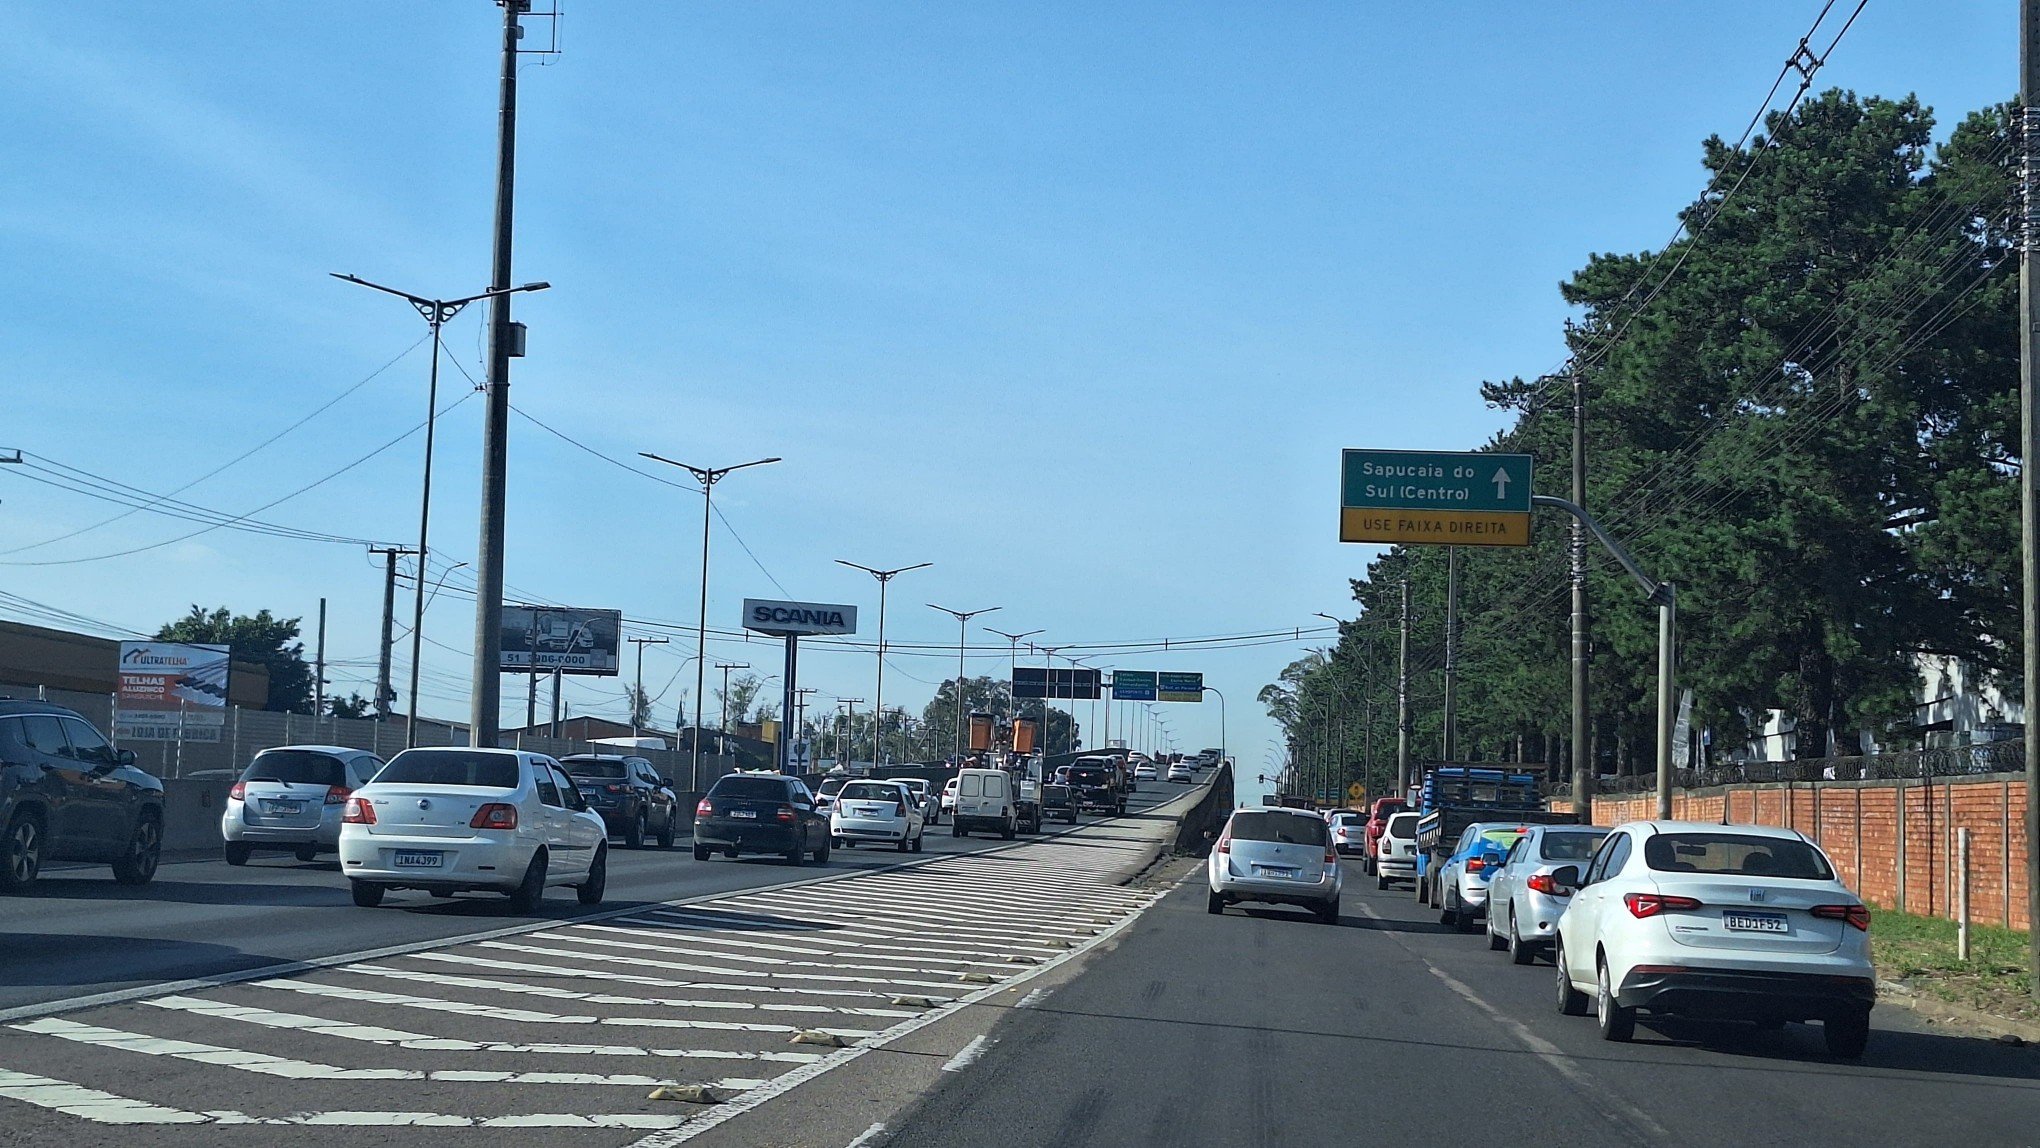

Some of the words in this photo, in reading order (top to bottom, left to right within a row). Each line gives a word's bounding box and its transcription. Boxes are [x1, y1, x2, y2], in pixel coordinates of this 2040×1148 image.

[1363, 462, 1443, 478] Sapucaia
[1454, 465, 1475, 478] do
[1366, 485, 1393, 498] Sul
[1400, 486, 1469, 500] (Centro)
[1363, 519, 1391, 531] USE
[1399, 520, 1443, 533] FAIXA
[1450, 522, 1506, 534] DIREITA
[753, 606, 845, 627] SCANIA
[140, 655, 187, 666] ULTRATELHA
[507, 653, 520, 663] 51
[122, 676, 165, 685] TELHAS
[132, 726, 155, 738] LOJA
[158, 727, 171, 739] DE
[400, 855, 438, 866] INA4J99
[1730, 917, 1781, 930] BED1F52
